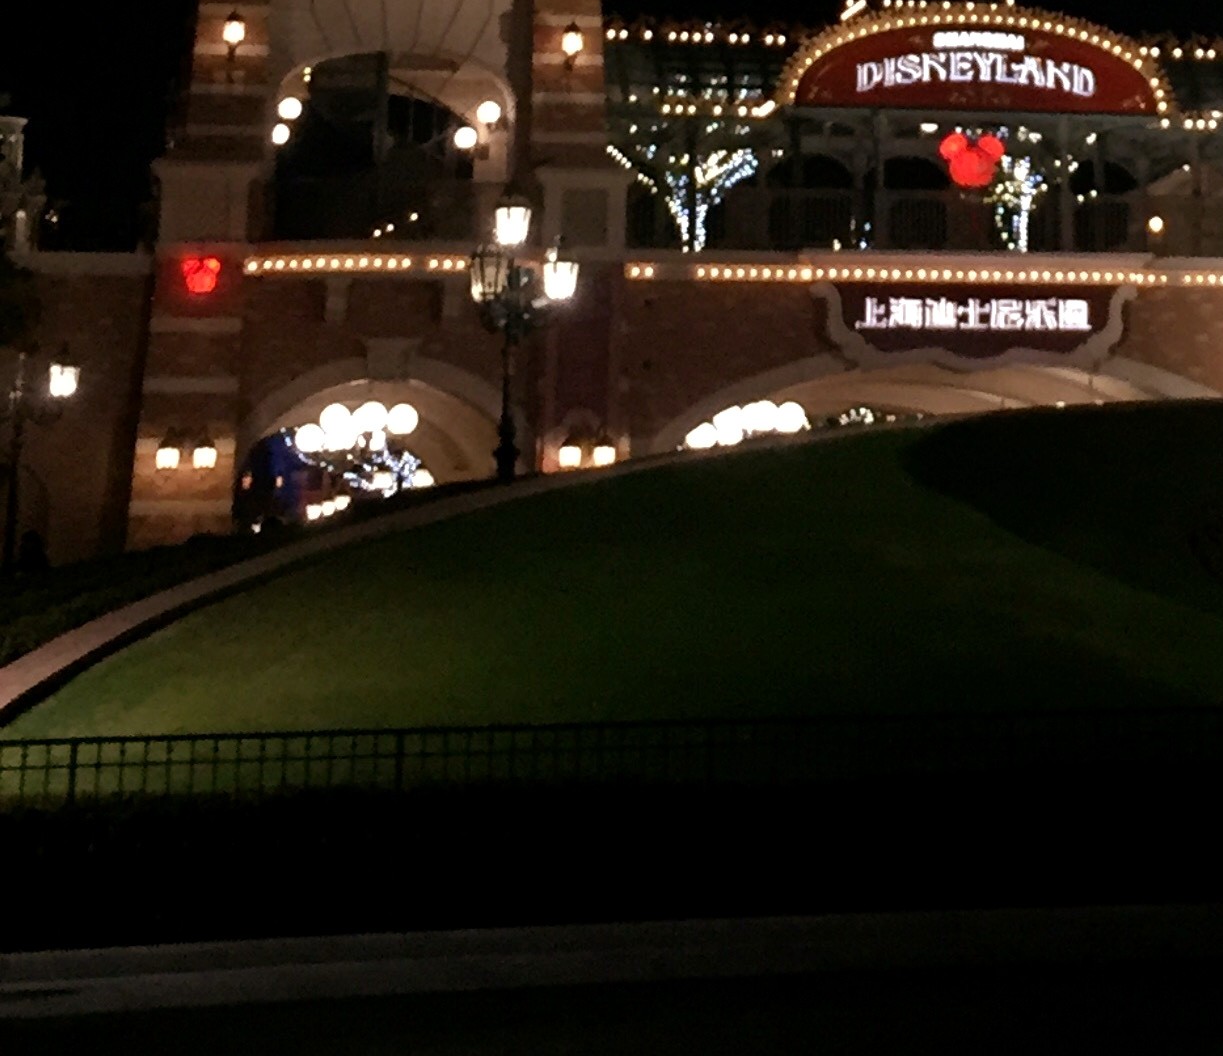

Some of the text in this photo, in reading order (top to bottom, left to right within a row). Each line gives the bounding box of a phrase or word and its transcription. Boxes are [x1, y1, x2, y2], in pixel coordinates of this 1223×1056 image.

[856, 52, 1095, 96] DISNEYLAND
[855, 296, 1092, 331] 上海迪士尼乐园
